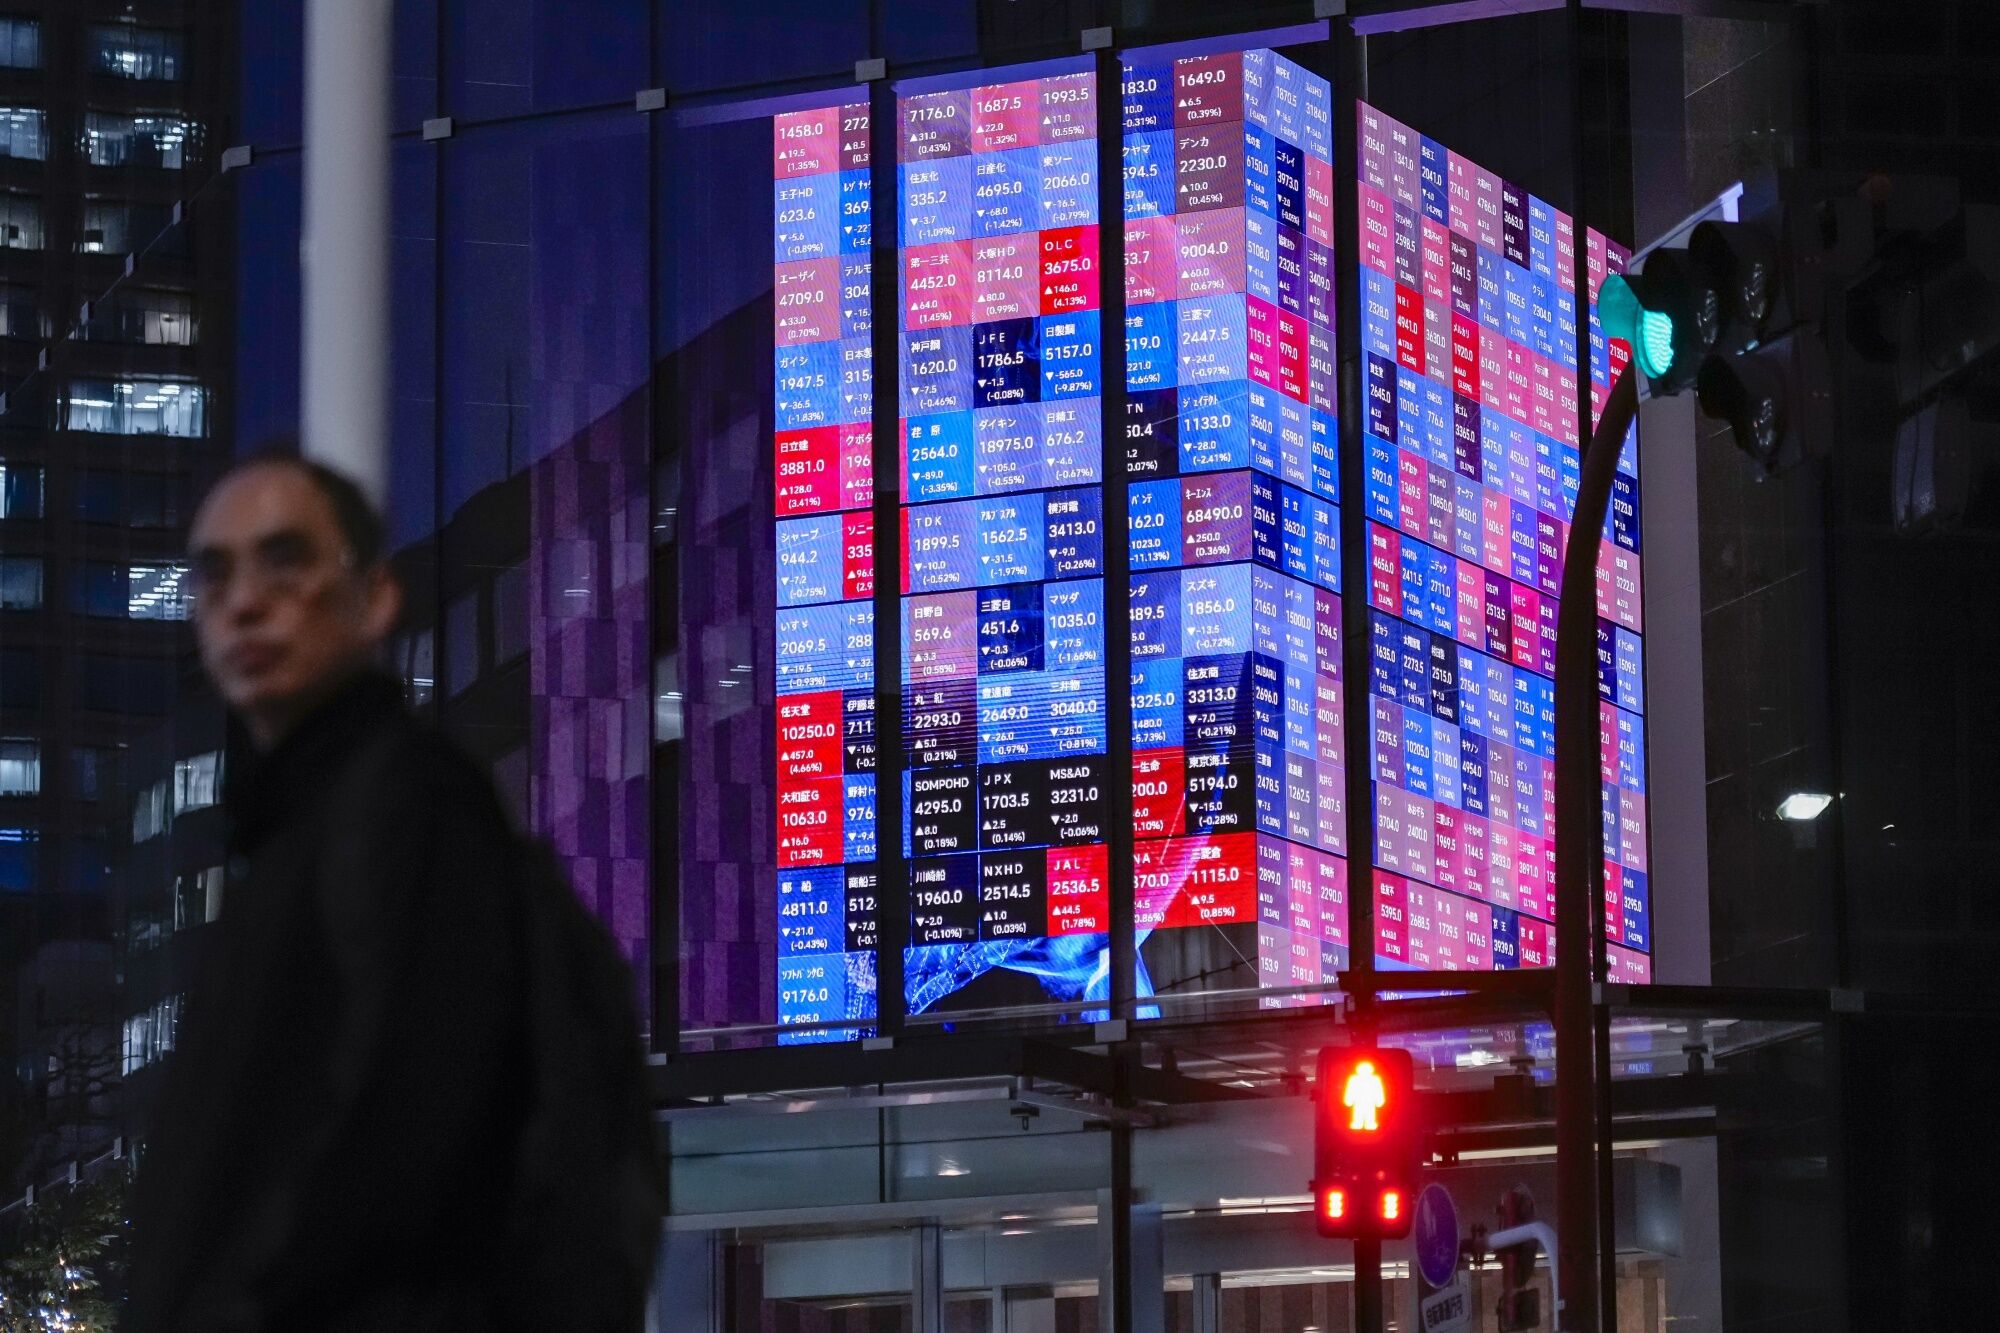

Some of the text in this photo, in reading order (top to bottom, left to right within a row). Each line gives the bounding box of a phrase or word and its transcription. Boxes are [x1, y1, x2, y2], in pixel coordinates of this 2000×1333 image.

[1180, 70, 1225, 87] 1649.0
[1043, 88, 1089, 104] 1993.5
[1276, 86, 1296, 107] 1870.5
[977, 97, 1021, 113] 1687.5
[910, 106, 955, 122] 7176.0
[1188, 108, 1221, 120] (0.39%)
[780, 123, 822, 139] 1458.0
[985, 134, 1017, 146] (1.32%)
[1180, 136, 1208, 149] デンカ
[788, 160, 819, 172] (1.35%)
[1043, 155, 1072, 167] 東ソー
[1180, 156, 1226, 173] 2230.0
[1277, 150, 1295, 167] ニチレイ
[977, 162, 1006, 175] 日産化
[1422, 166, 1441, 186] 2041.0
[910, 171, 938, 184] 住友化
[1044, 173, 1089, 189] 2066.0
[1277, 171, 1298, 192] 3973.0
[779, 188, 812, 200] 王子HD
[977, 181, 1022, 198] 4695.0
[1308, 187, 1328, 207] 3996.0
[911, 191, 947, 206] 335.2
[779, 209, 815, 223] 623.6
[1181, 242, 1228, 258] 9004.0
[1396, 233, 1415, 252] 2598.5
[911, 254, 949, 268] 第一三共
[977, 247, 1015, 260] 大塚HD
[1045, 258, 1090, 275] 3675.0
[1279, 256, 1300, 276] 2328.5
[780, 270, 815, 283] エーザイ
[911, 275, 956, 290] 4452.0
[977, 266, 1022, 283] 8114.0
[779, 291, 823, 306] 4709.0
[1054, 296, 1086, 308] (4.13%)
[1398, 315, 1417, 335] 4941.0
[1454, 325, 1470, 338] メルカリ
[788, 328, 819, 339] (0.70%)
[1183, 328, 1229, 345] 2447.5
[1250, 327, 1271, 348] 1151.5
[911, 340, 940, 353] 神戸鋼
[1046, 344, 1092, 361] 5157.0
[1280, 341, 1298, 360] 979.0
[780, 356, 808, 368] ガイシ
[912, 359, 956, 375] 1620.0
[978, 351, 1024, 368] 1786.5
[1311, 356, 1332, 376] 3414.0
[781, 375, 824, 390] 1947.5
[979, 418, 1016, 431] ダイキン
[1047, 411, 1076, 423] 日精工
[1185, 415, 1231, 431] 1133.0
[1428, 410, 1443, 428] 776.6
[781, 440, 808, 453] 日立建
[980, 437, 1033, 453] 18975.0
[1047, 431, 1084, 446] 676.2
[912, 445, 957, 461] 2564.0
[780, 459, 824, 475] 3881.0
[1372, 468, 1392, 487] 5921.0
[921, 482, 957, 495] (-3.35%)
[789, 497, 820, 509] (3.41%)
[1048, 501, 1078, 514] 横河電
[1186, 505, 1242, 523] 68490.0
[1254, 506, 1275, 526] 2516.5
[1049, 521, 1095, 537] 3413.0
[1284, 518, 1305, 538] 3632.0
[915, 535, 959, 552] 1899.5
[982, 528, 1027, 545] 1562.5
[1315, 531, 1335, 550] 2591.0
[781, 551, 817, 565] 944.2
[1058, 559, 1095, 571] (-0.26%)
[1187, 579, 1217, 591] スズキ
[1402, 568, 1422, 587] 2411.5
[981, 599, 1011, 612] 三菱自
[1050, 592, 1079, 603] マツダ
[914, 606, 943, 619] 日野自
[1188, 599, 1234, 615] 1856.0
[981, 620, 1019, 635] 451.6
[1050, 612, 1095, 629] 1035.0
[1514, 614, 1536, 633] 13260.0
[915, 627, 951, 642] 569.6
[781, 639, 825, 655] 2069.5
[991, 656, 1027, 669] (-0.06%)
[1188, 667, 1218, 680] 住友商
[1255, 664, 1277, 681] SUBARU
[1432, 666, 1452, 685] 2515.0
[1188, 687, 1236, 703] 3313.0
[1256, 687, 1278, 705] 2696.0
[781, 704, 810, 718] 任天堂
[982, 706, 1028, 723] 2649.0
[1050, 700, 1096, 717] 3040.0
[1288, 698, 1308, 716] 1316.5
[915, 712, 960, 729] 2293.0
[1318, 707, 1338, 726] 4009.0
[782, 724, 834, 740] 10250.0
[1198, 725, 1236, 738] (-0.21%)
[1406, 739, 1429, 759] 10205.0
[790, 762, 822, 774] (4.66%)
[1189, 754, 1230, 769] 東京海上
[1462, 761, 1481, 778] 4954.0
[1050, 767, 1090, 780] MS&AD
[915, 777, 969, 791] SOMPOHD
[1190, 776, 1237, 792] 5194.0
[781, 790, 819, 804] 大和証G
[984, 793, 1029, 810] 1703.5
[1051, 787, 1098, 804] 3231.0
[1319, 794, 1341, 813] 2607.5
[915, 800, 961, 816] 4295.0
[782, 811, 827, 827] 1063.0
[1199, 814, 1238, 827] (-0.28%)
[1379, 816, 1399, 833] 3704.0
[992, 832, 1025, 844] (0.14%)
[1061, 826, 1098, 838] (-0.06%)
[925, 837, 957, 850] (0.18%)
[790, 849, 823, 861] (1.52%)
[984, 864, 1023, 877] NXHD
[1192, 867, 1239, 884] 1115.0
[1259, 867, 1281, 886] 2899.0
[984, 884, 1030, 901] 2514.5
[1053, 879, 1099, 895] 2536.5
[917, 890, 962, 907] 1960.0
[1624, 895, 1642, 913] 3295.0
[782, 901, 827, 916] 4811.0
[1201, 906, 1235, 918] (0.85%)
[1062, 917, 1095, 930] (1.78%)
[1494, 939, 1513, 956] 3939.0
[1261, 956, 1279, 974] 153.9
[1292, 965, 1314, 983] 5181.0
[783, 988, 828, 1003] 9176.0
